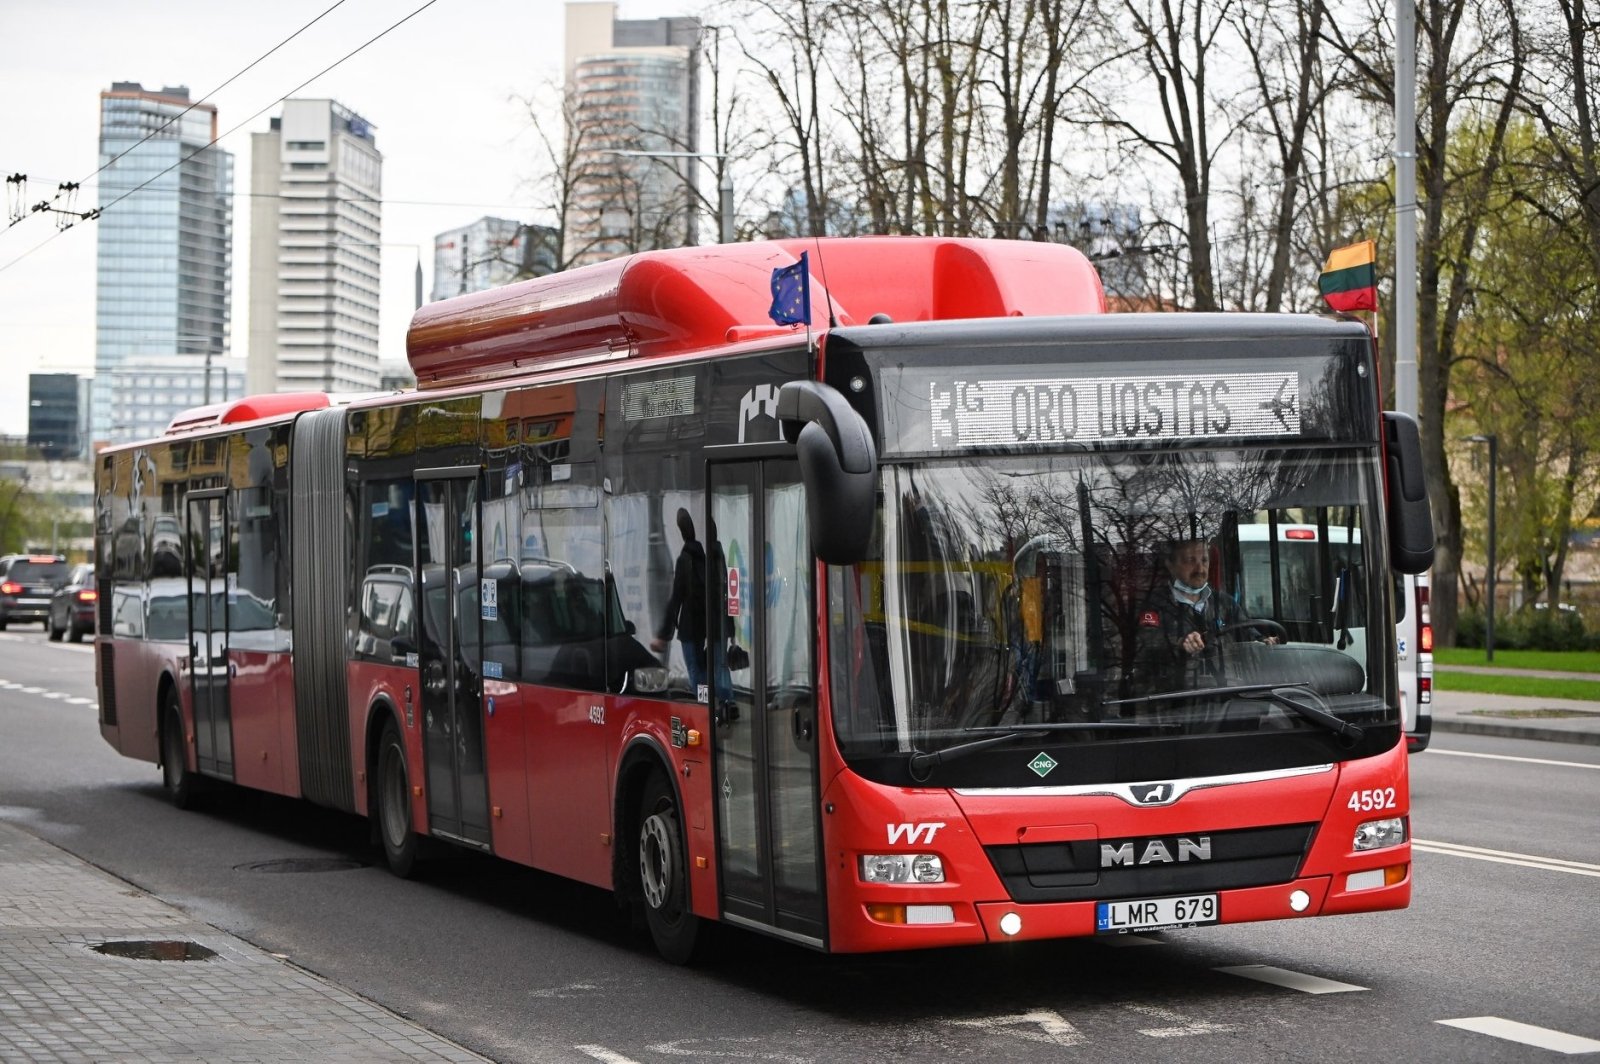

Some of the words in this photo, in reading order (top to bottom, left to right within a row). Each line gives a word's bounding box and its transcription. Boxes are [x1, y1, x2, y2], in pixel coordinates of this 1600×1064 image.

[1011, 384, 1079, 442] ORO
[1096, 379, 1232, 438] UOSTAS
[588, 704, 606, 725] 4592
[1033, 760, 1052, 769] CNG
[1347, 787, 1397, 812] 4592
[886, 822, 947, 845] VVT
[1100, 836, 1212, 868] MAN
[1098, 918, 1108, 926] LT
[1111, 902, 1159, 926] LMR
[1174, 897, 1214, 921] 679
